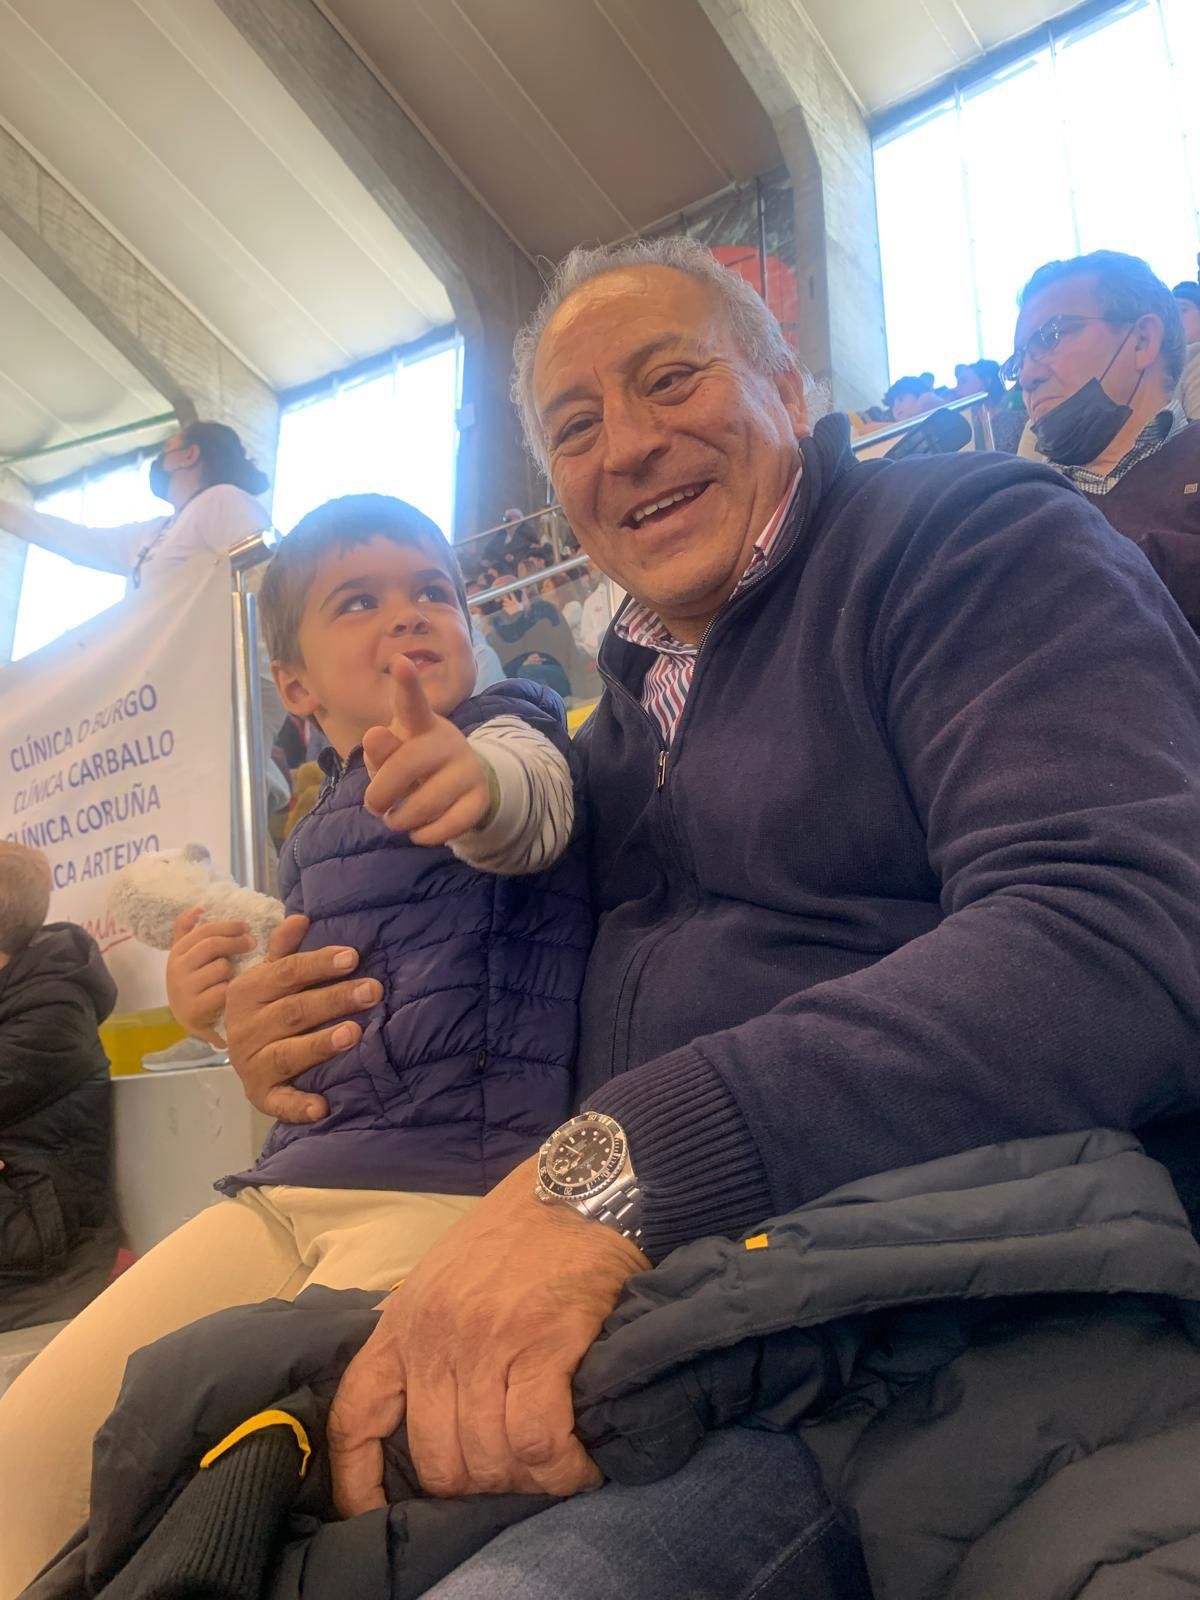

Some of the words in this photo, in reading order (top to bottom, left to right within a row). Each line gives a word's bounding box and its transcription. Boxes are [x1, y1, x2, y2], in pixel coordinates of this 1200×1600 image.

[10, 728, 73, 772] CLÍNICA
[13, 770, 64, 814] CLÍNICA
[68, 729, 174, 788] CARBALLO
[76, 782, 160, 834] CORUÑA
